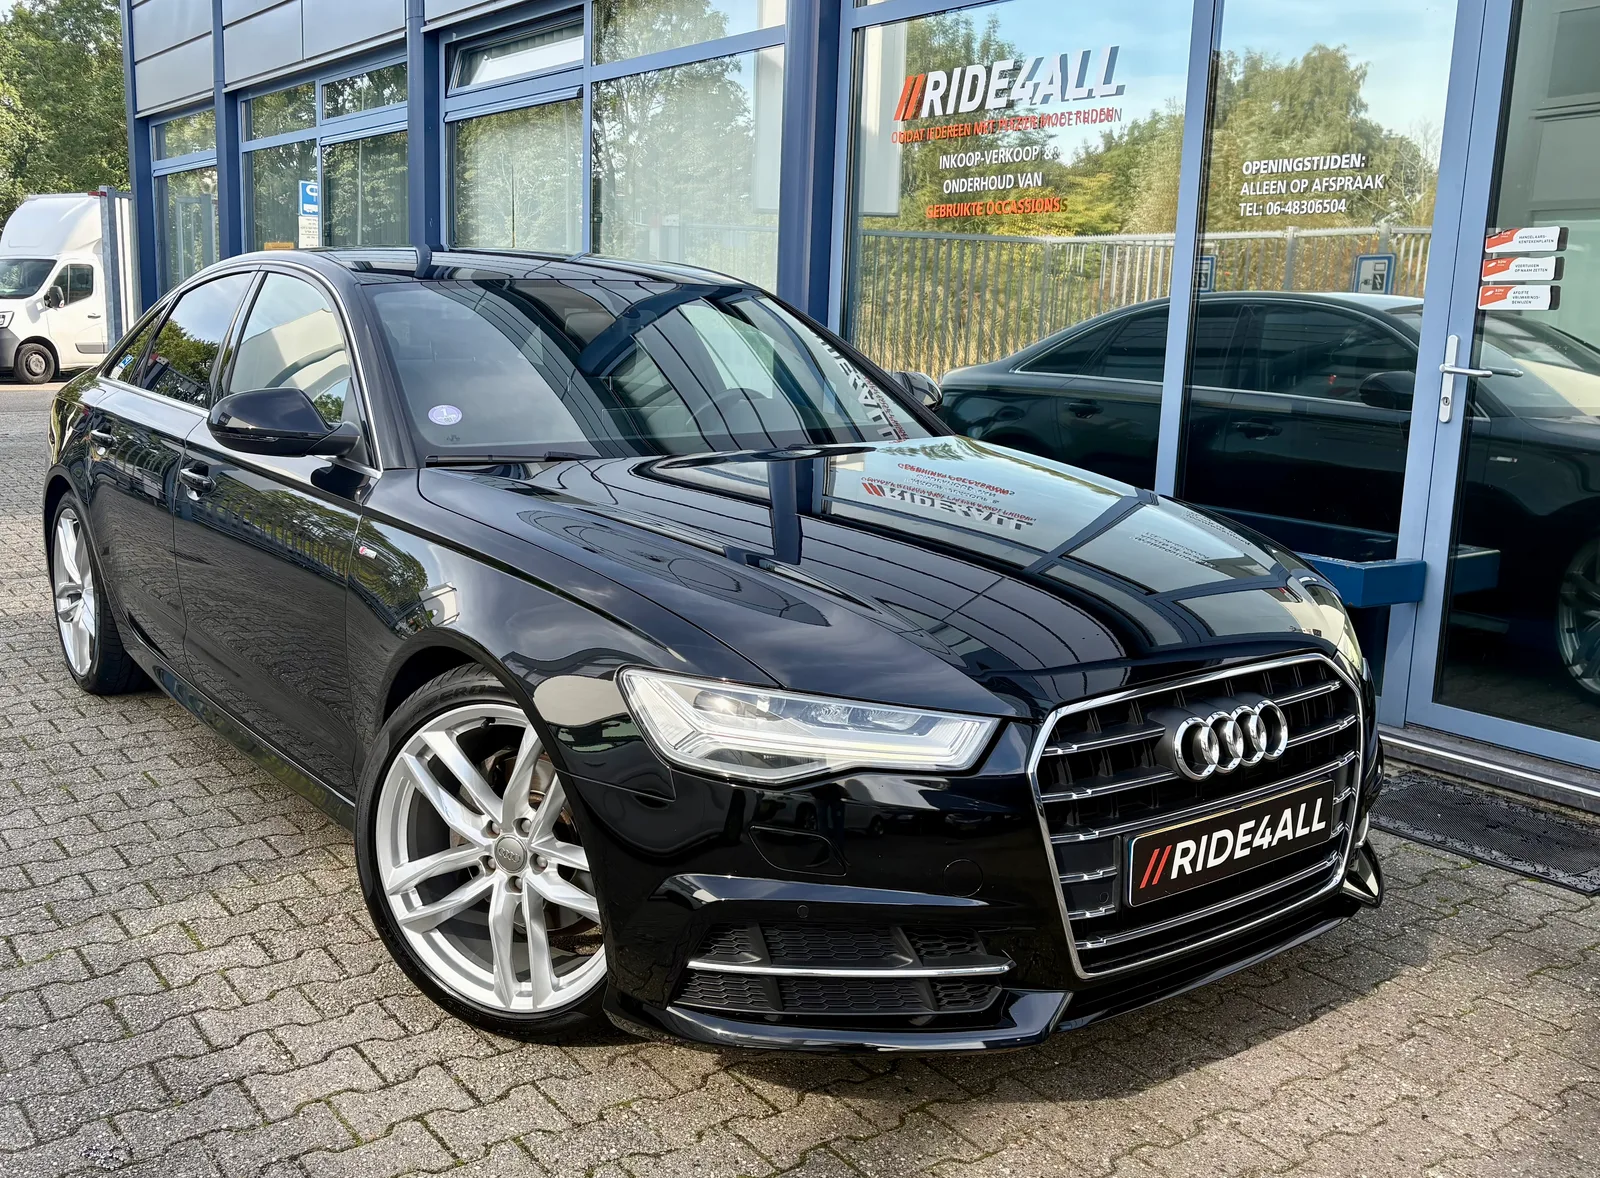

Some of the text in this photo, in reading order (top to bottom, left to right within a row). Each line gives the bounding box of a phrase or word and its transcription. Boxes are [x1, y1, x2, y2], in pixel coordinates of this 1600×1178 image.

[926, 122, 972, 140] IEDEREEN
[973, 118, 996, 136] MET
[939, 145, 1053, 170] INKOOP-VERKOOP &
[1242, 153, 1367, 175] OPENINGSTIJDEN:
[943, 171, 1043, 194] ONDERHOUD VAN
[1240, 173, 1386, 197] ALLEEN OP AFSPRAAK
[926, 197, 1061, 219] GEBRUIKTE OCCASSIONS
[1239, 198, 1347, 217] TEL: 06-48306504
